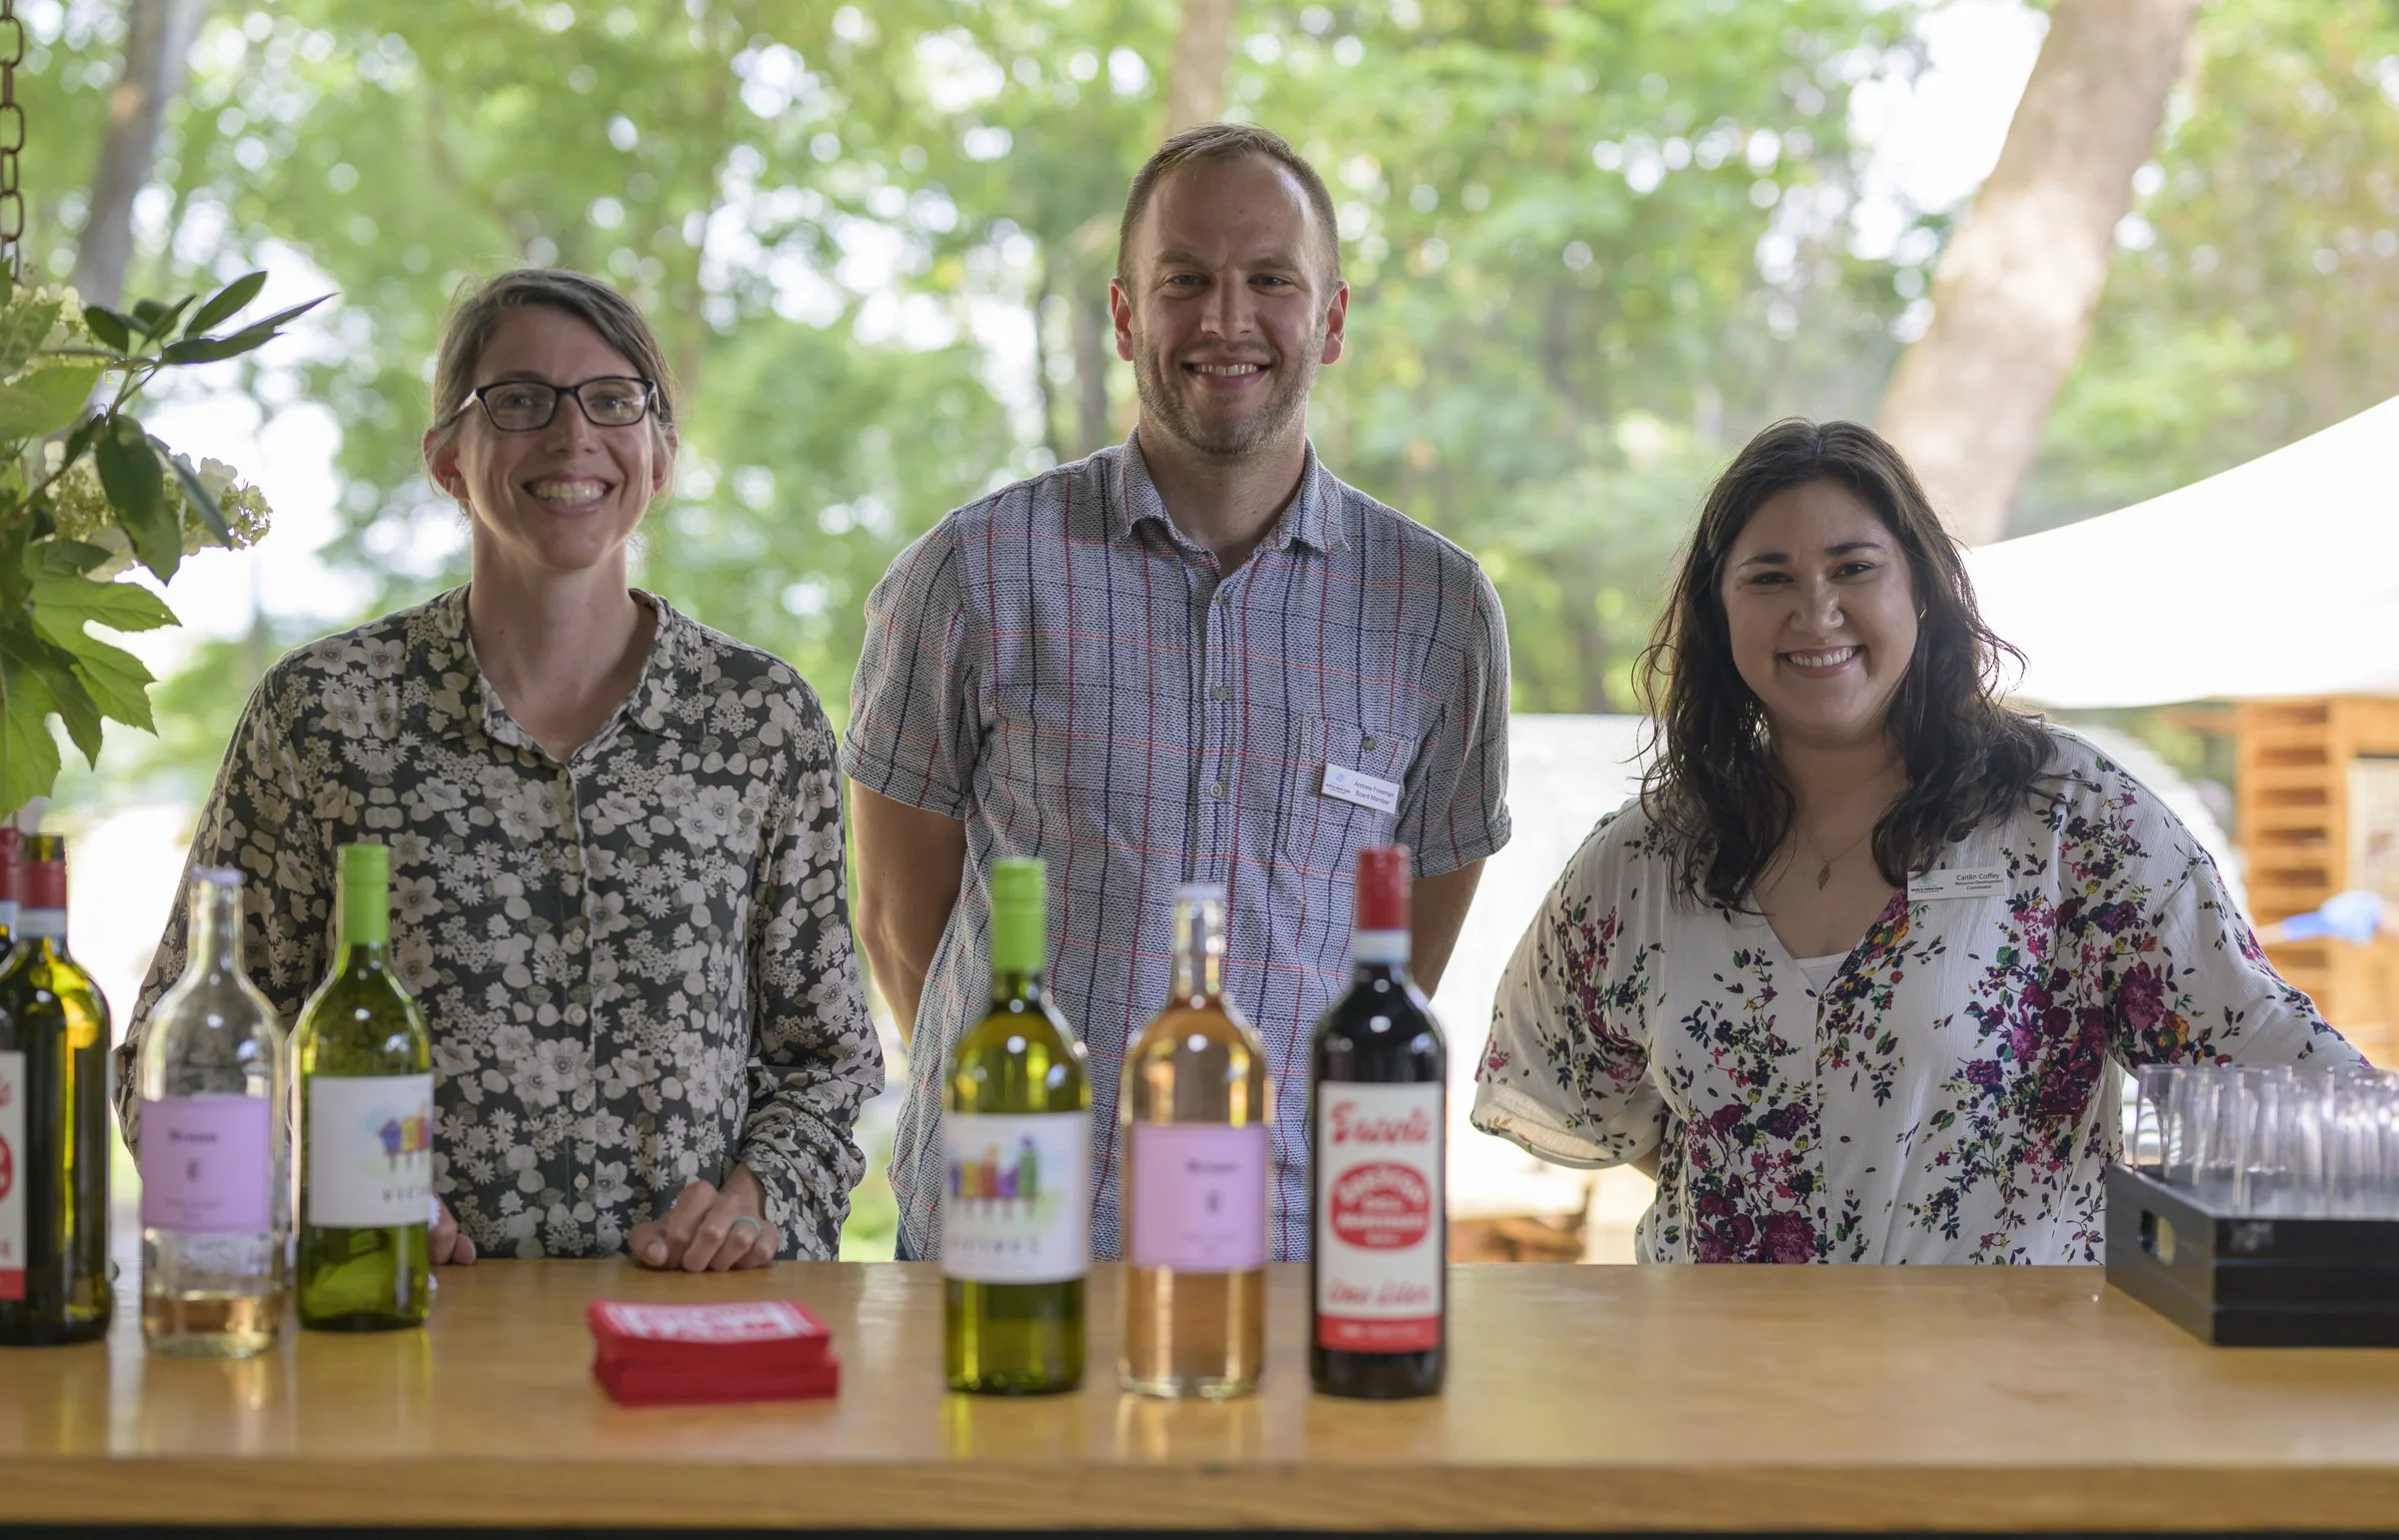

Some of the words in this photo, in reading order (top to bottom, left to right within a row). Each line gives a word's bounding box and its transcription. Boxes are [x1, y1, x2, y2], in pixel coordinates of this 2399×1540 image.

[1354, 780, 1372, 791] Andrew
[1372, 786, 1394, 797] Freeman
[1355, 790, 1370, 800] Board
[1370, 794, 1390, 805] Member
